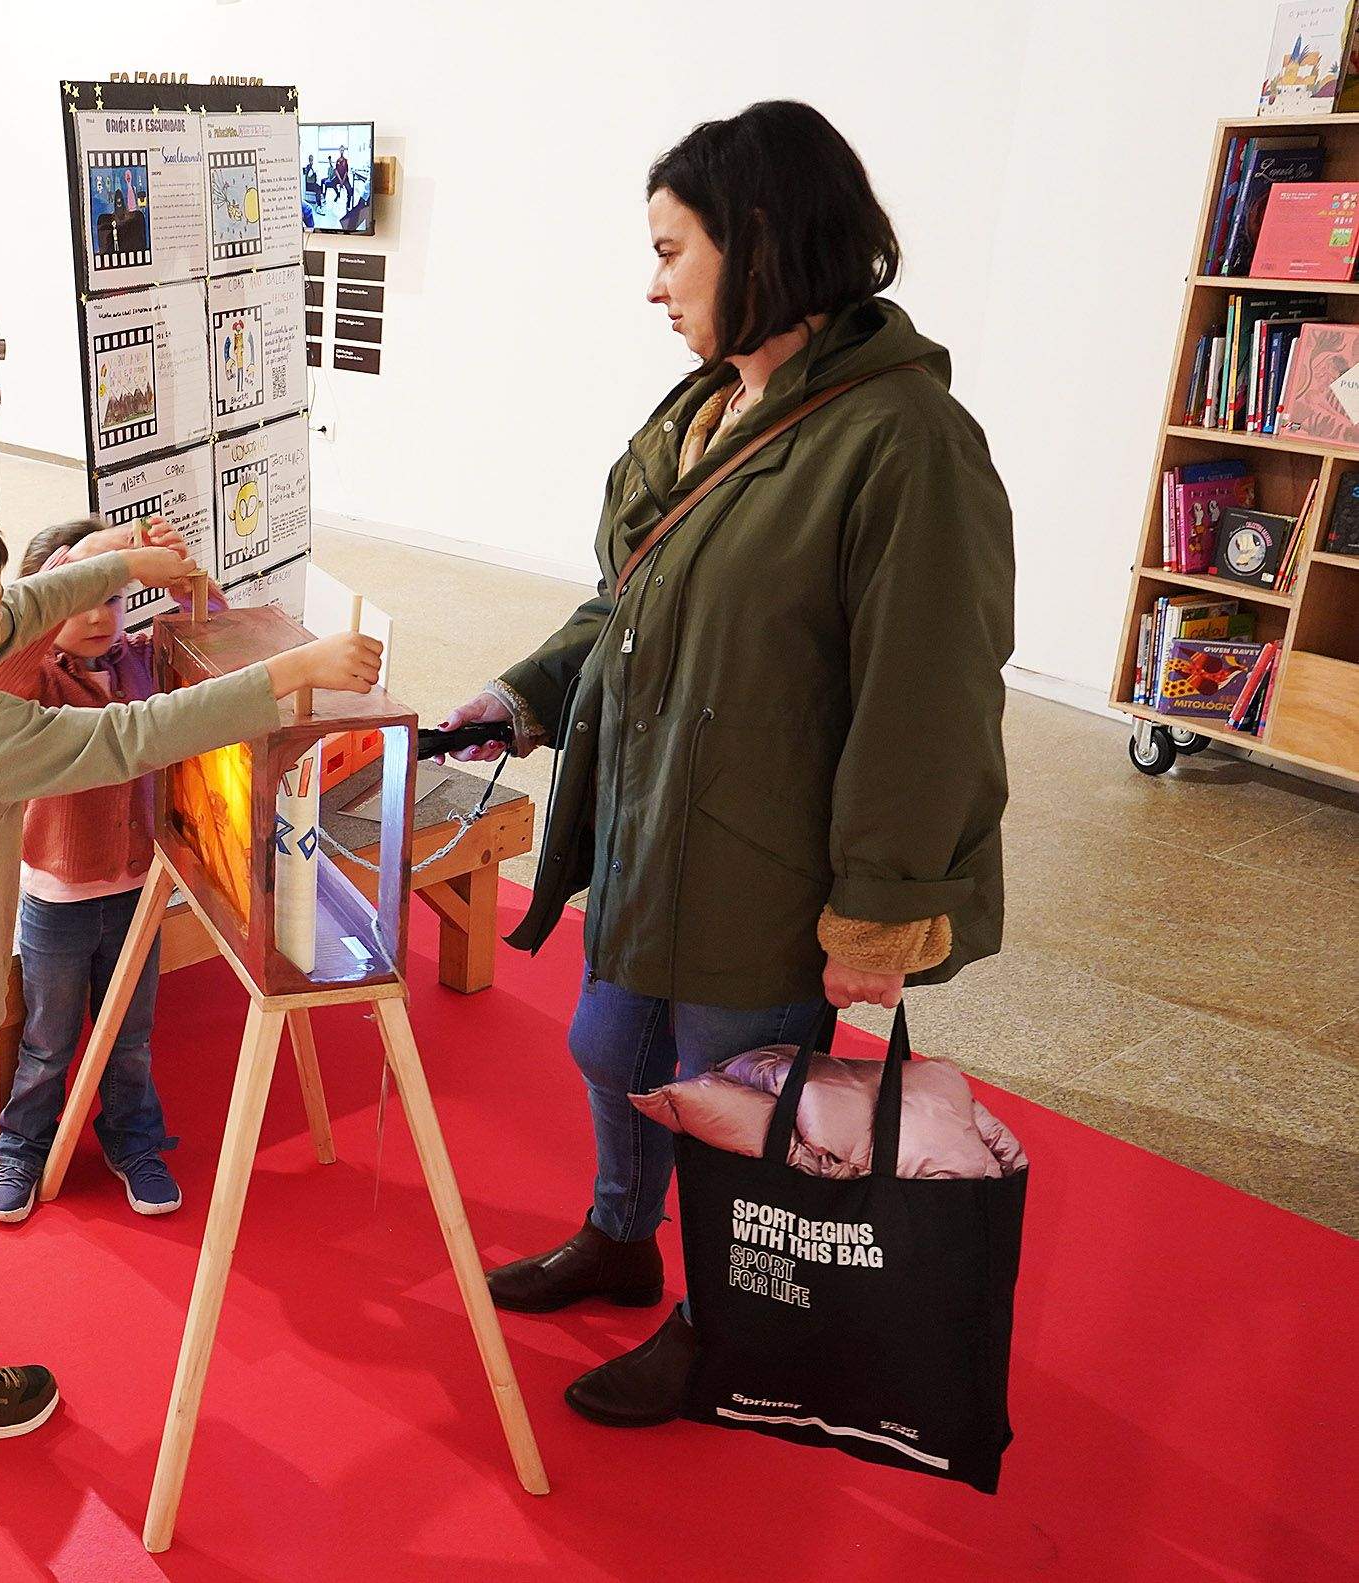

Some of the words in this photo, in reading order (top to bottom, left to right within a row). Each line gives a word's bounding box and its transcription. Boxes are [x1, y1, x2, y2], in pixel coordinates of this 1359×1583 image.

[1203, 646, 1230, 654] OWEN
[1232, 648, 1261, 656] DAVEY
[1173, 699, 1235, 712] MITOLÓGIC
[733, 1198, 796, 1232] SPORT
[798, 1217, 874, 1245] BEGINS
[732, 1218, 784, 1251] WITH
[788, 1234, 832, 1264] THIS
[837, 1245, 884, 1268] BAG
[730, 1244, 795, 1281] SPORT
[729, 1266, 768, 1296] FOR
[771, 1277, 811, 1309] LIFE
[731, 1393, 802, 1410] Sprinter
